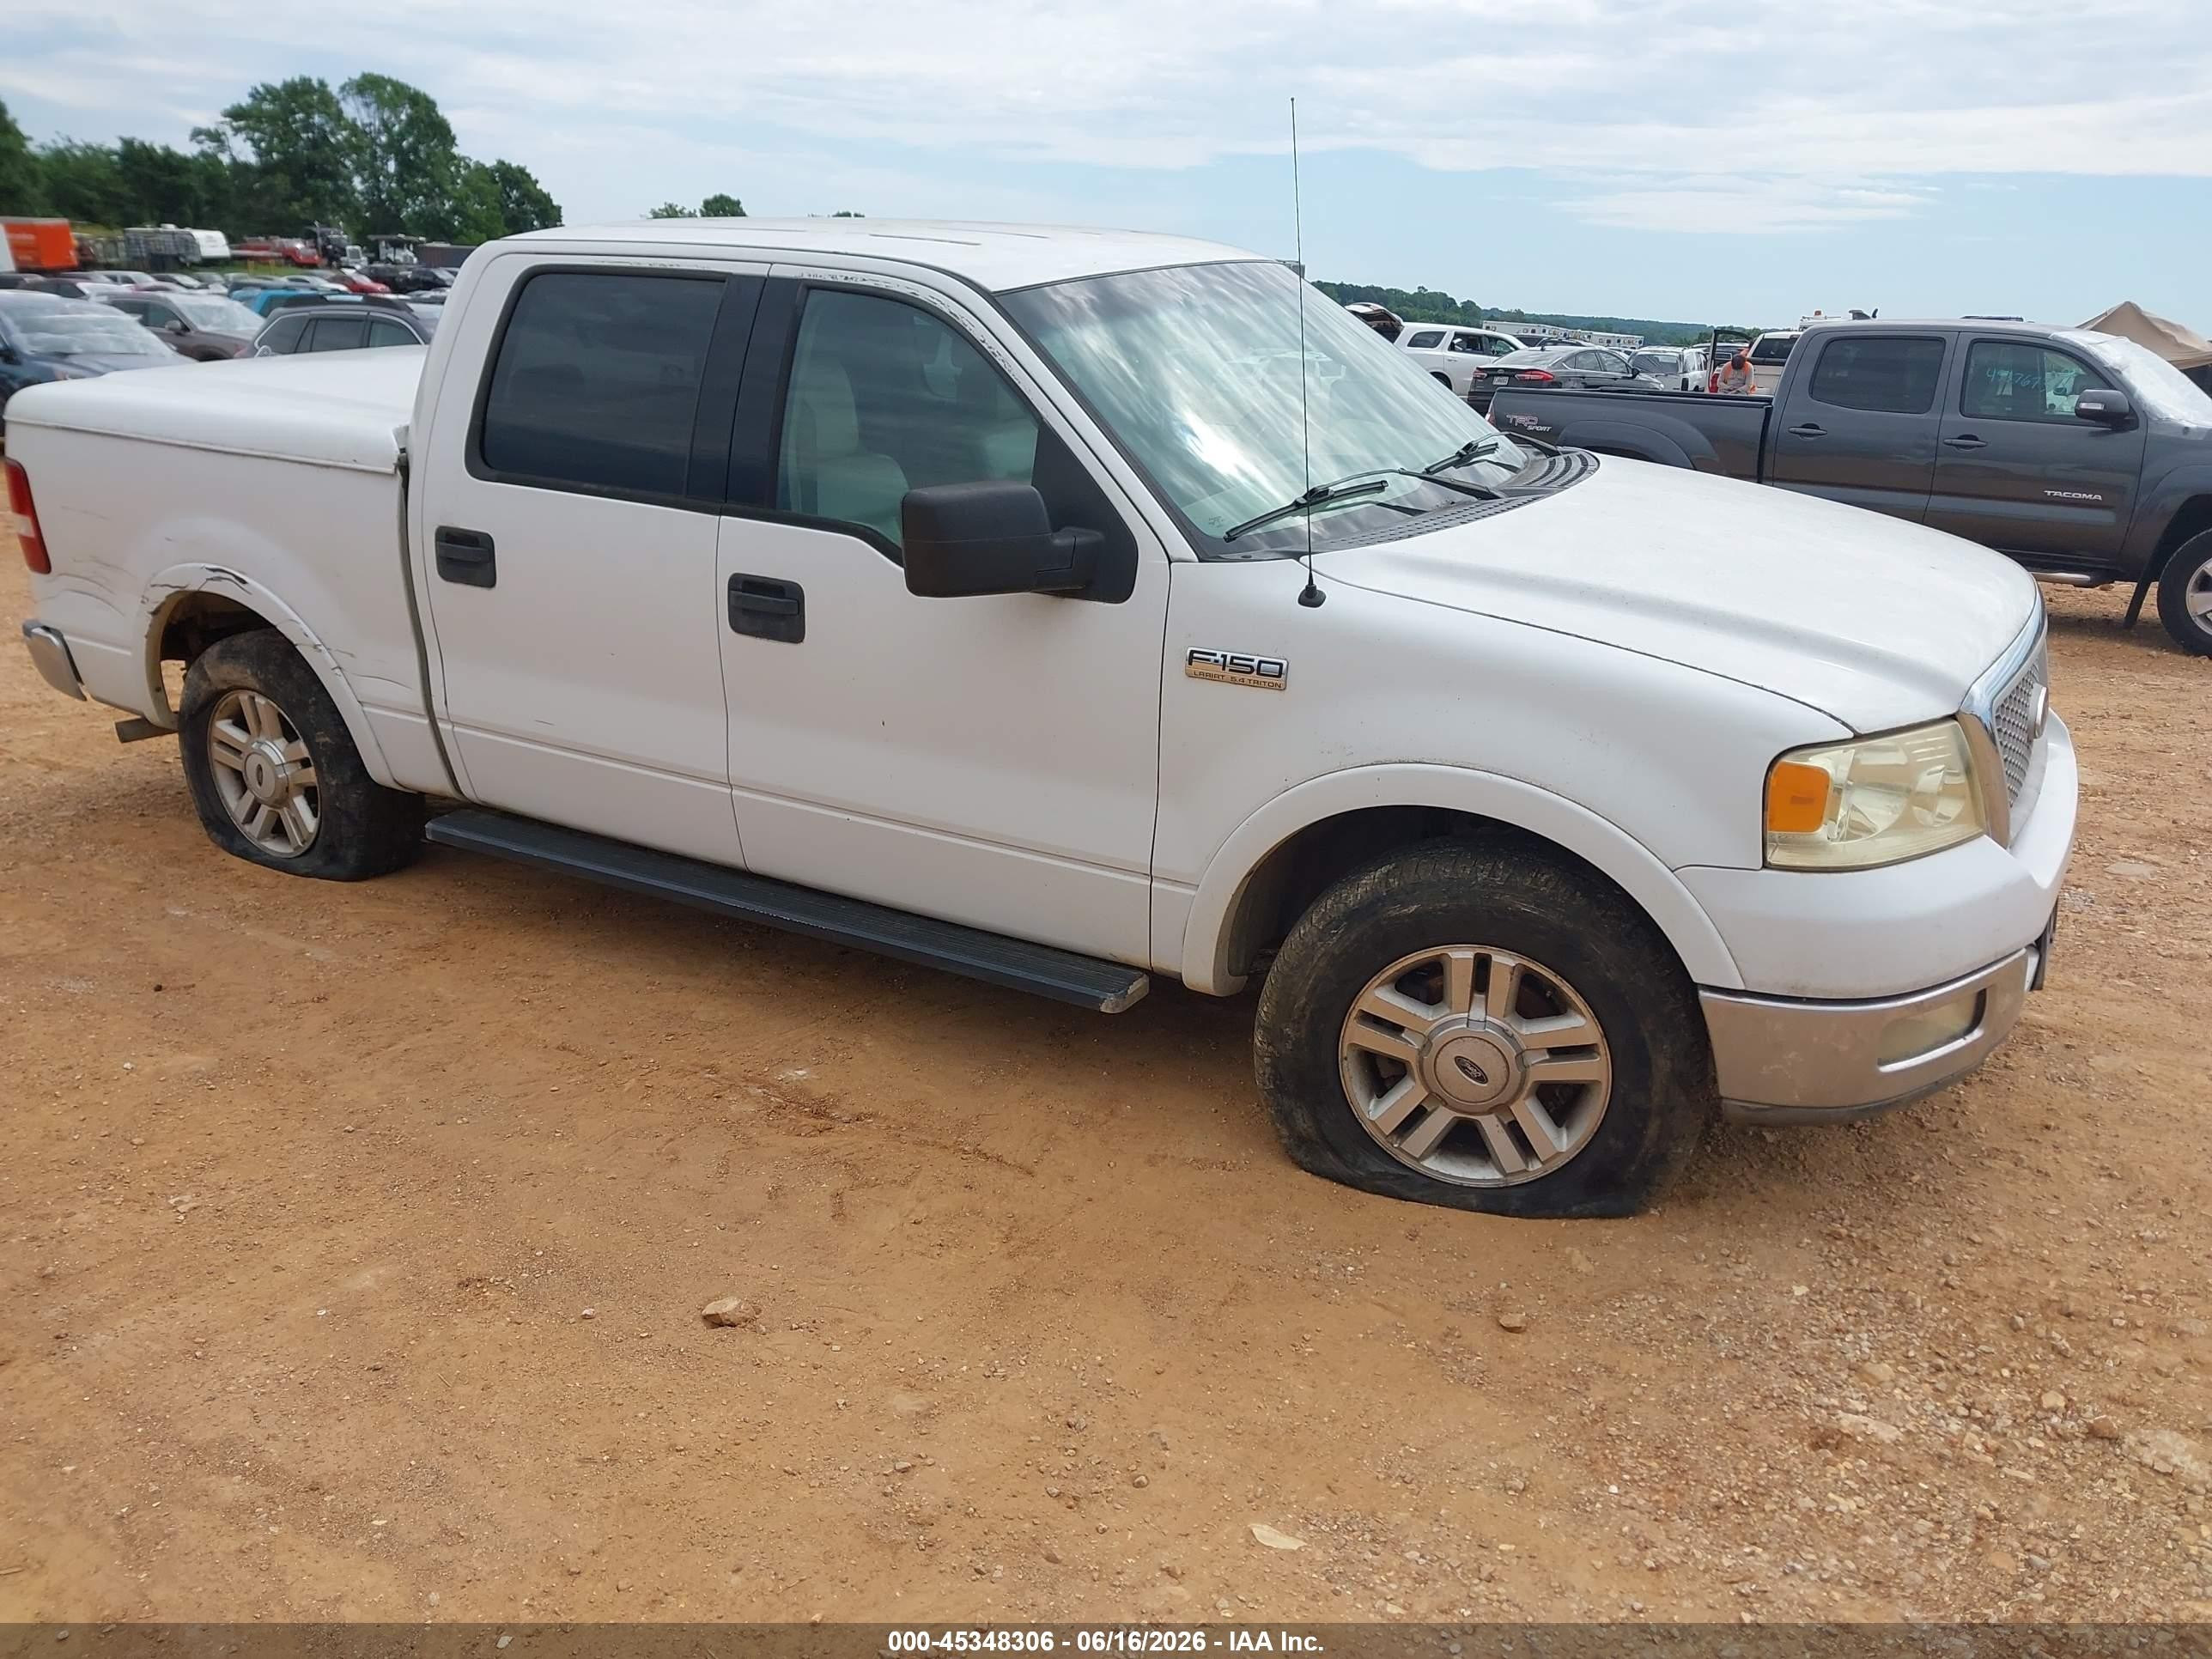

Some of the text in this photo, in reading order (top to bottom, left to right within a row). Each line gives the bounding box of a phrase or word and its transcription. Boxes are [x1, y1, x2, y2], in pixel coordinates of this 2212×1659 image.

[1505, 414, 1539, 427] TRD
[2044, 490, 2103, 501] TACOMA
[1188, 649, 1284, 678] F-150
[1194, 671, 1225, 681] LARIAT
[1249, 678, 1282, 689] TRITON
